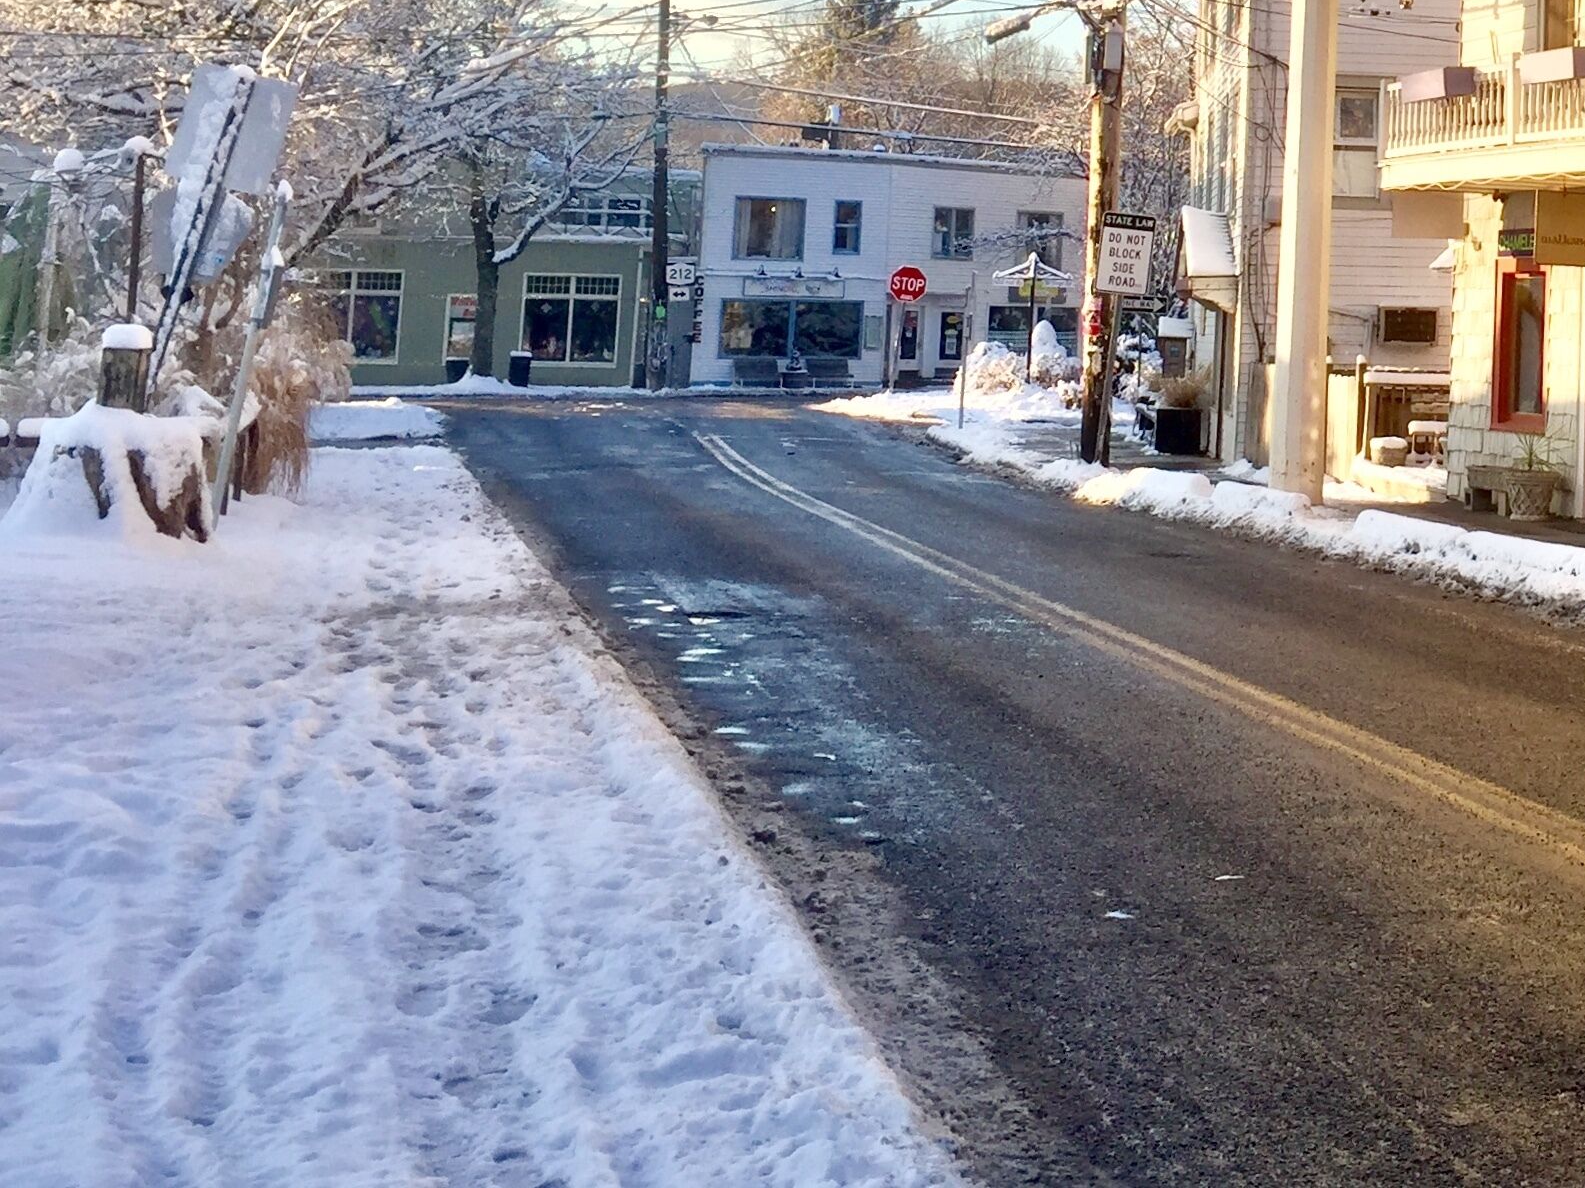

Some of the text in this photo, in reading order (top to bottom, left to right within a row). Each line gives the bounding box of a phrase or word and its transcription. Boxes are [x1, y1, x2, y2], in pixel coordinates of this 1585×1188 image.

[1105, 214, 1155, 229] STATE LAW
[1109, 232, 1146, 246] DO NOT
[1109, 247, 1142, 260] BLOCK
[669, 268, 692, 280] 212
[1112, 262, 1135, 274] SIDE
[892, 275, 925, 292] STOP
[1108, 275, 1136, 288] ROAD
[693, 275, 705, 343] COFFEE
